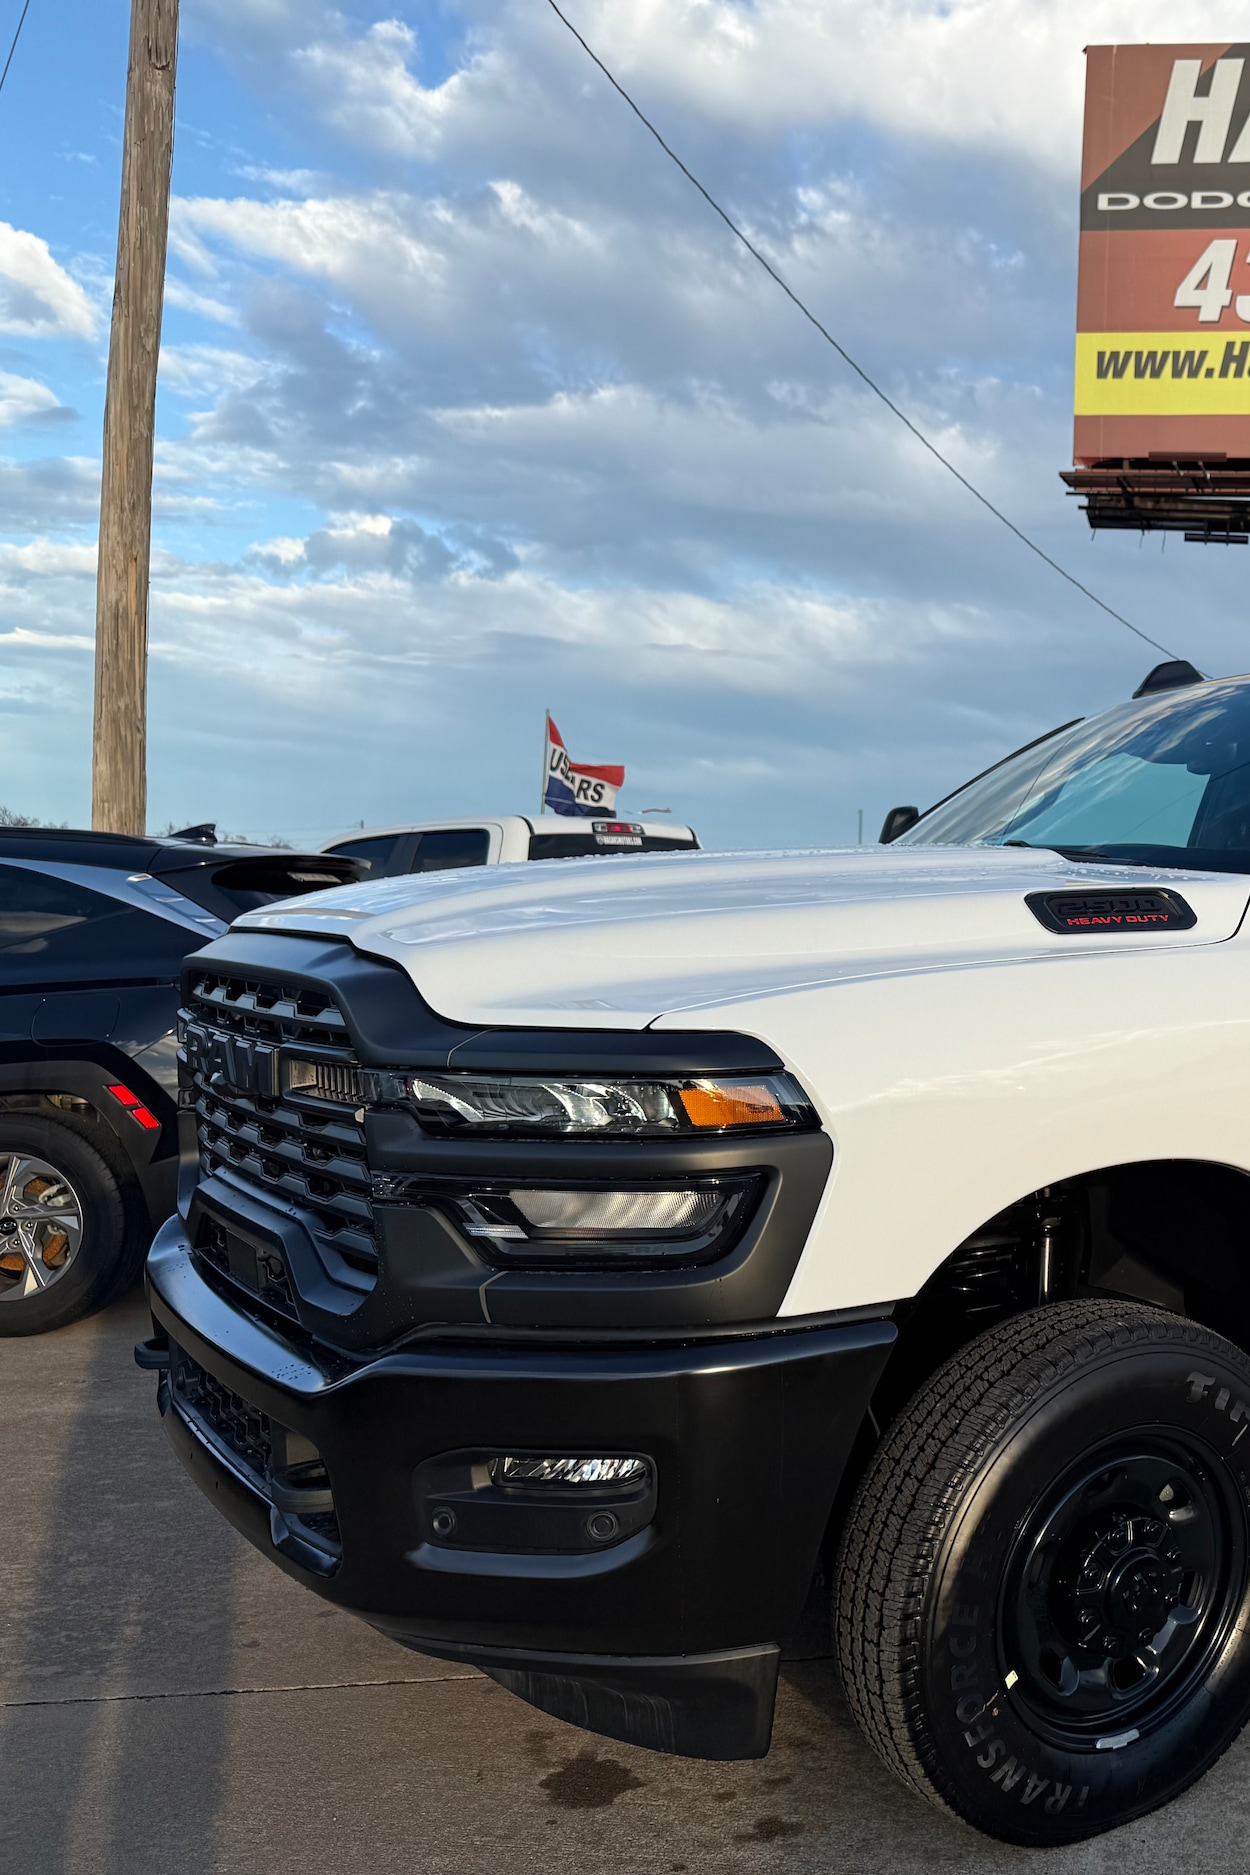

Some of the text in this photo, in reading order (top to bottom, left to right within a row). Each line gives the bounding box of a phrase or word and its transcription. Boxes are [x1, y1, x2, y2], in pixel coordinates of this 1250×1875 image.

[1057, 898, 1163, 916] 2500
[1066, 914, 1169, 926] HEAVY DUTY
[948, 1603, 1091, 1815] TRANSFORCE
